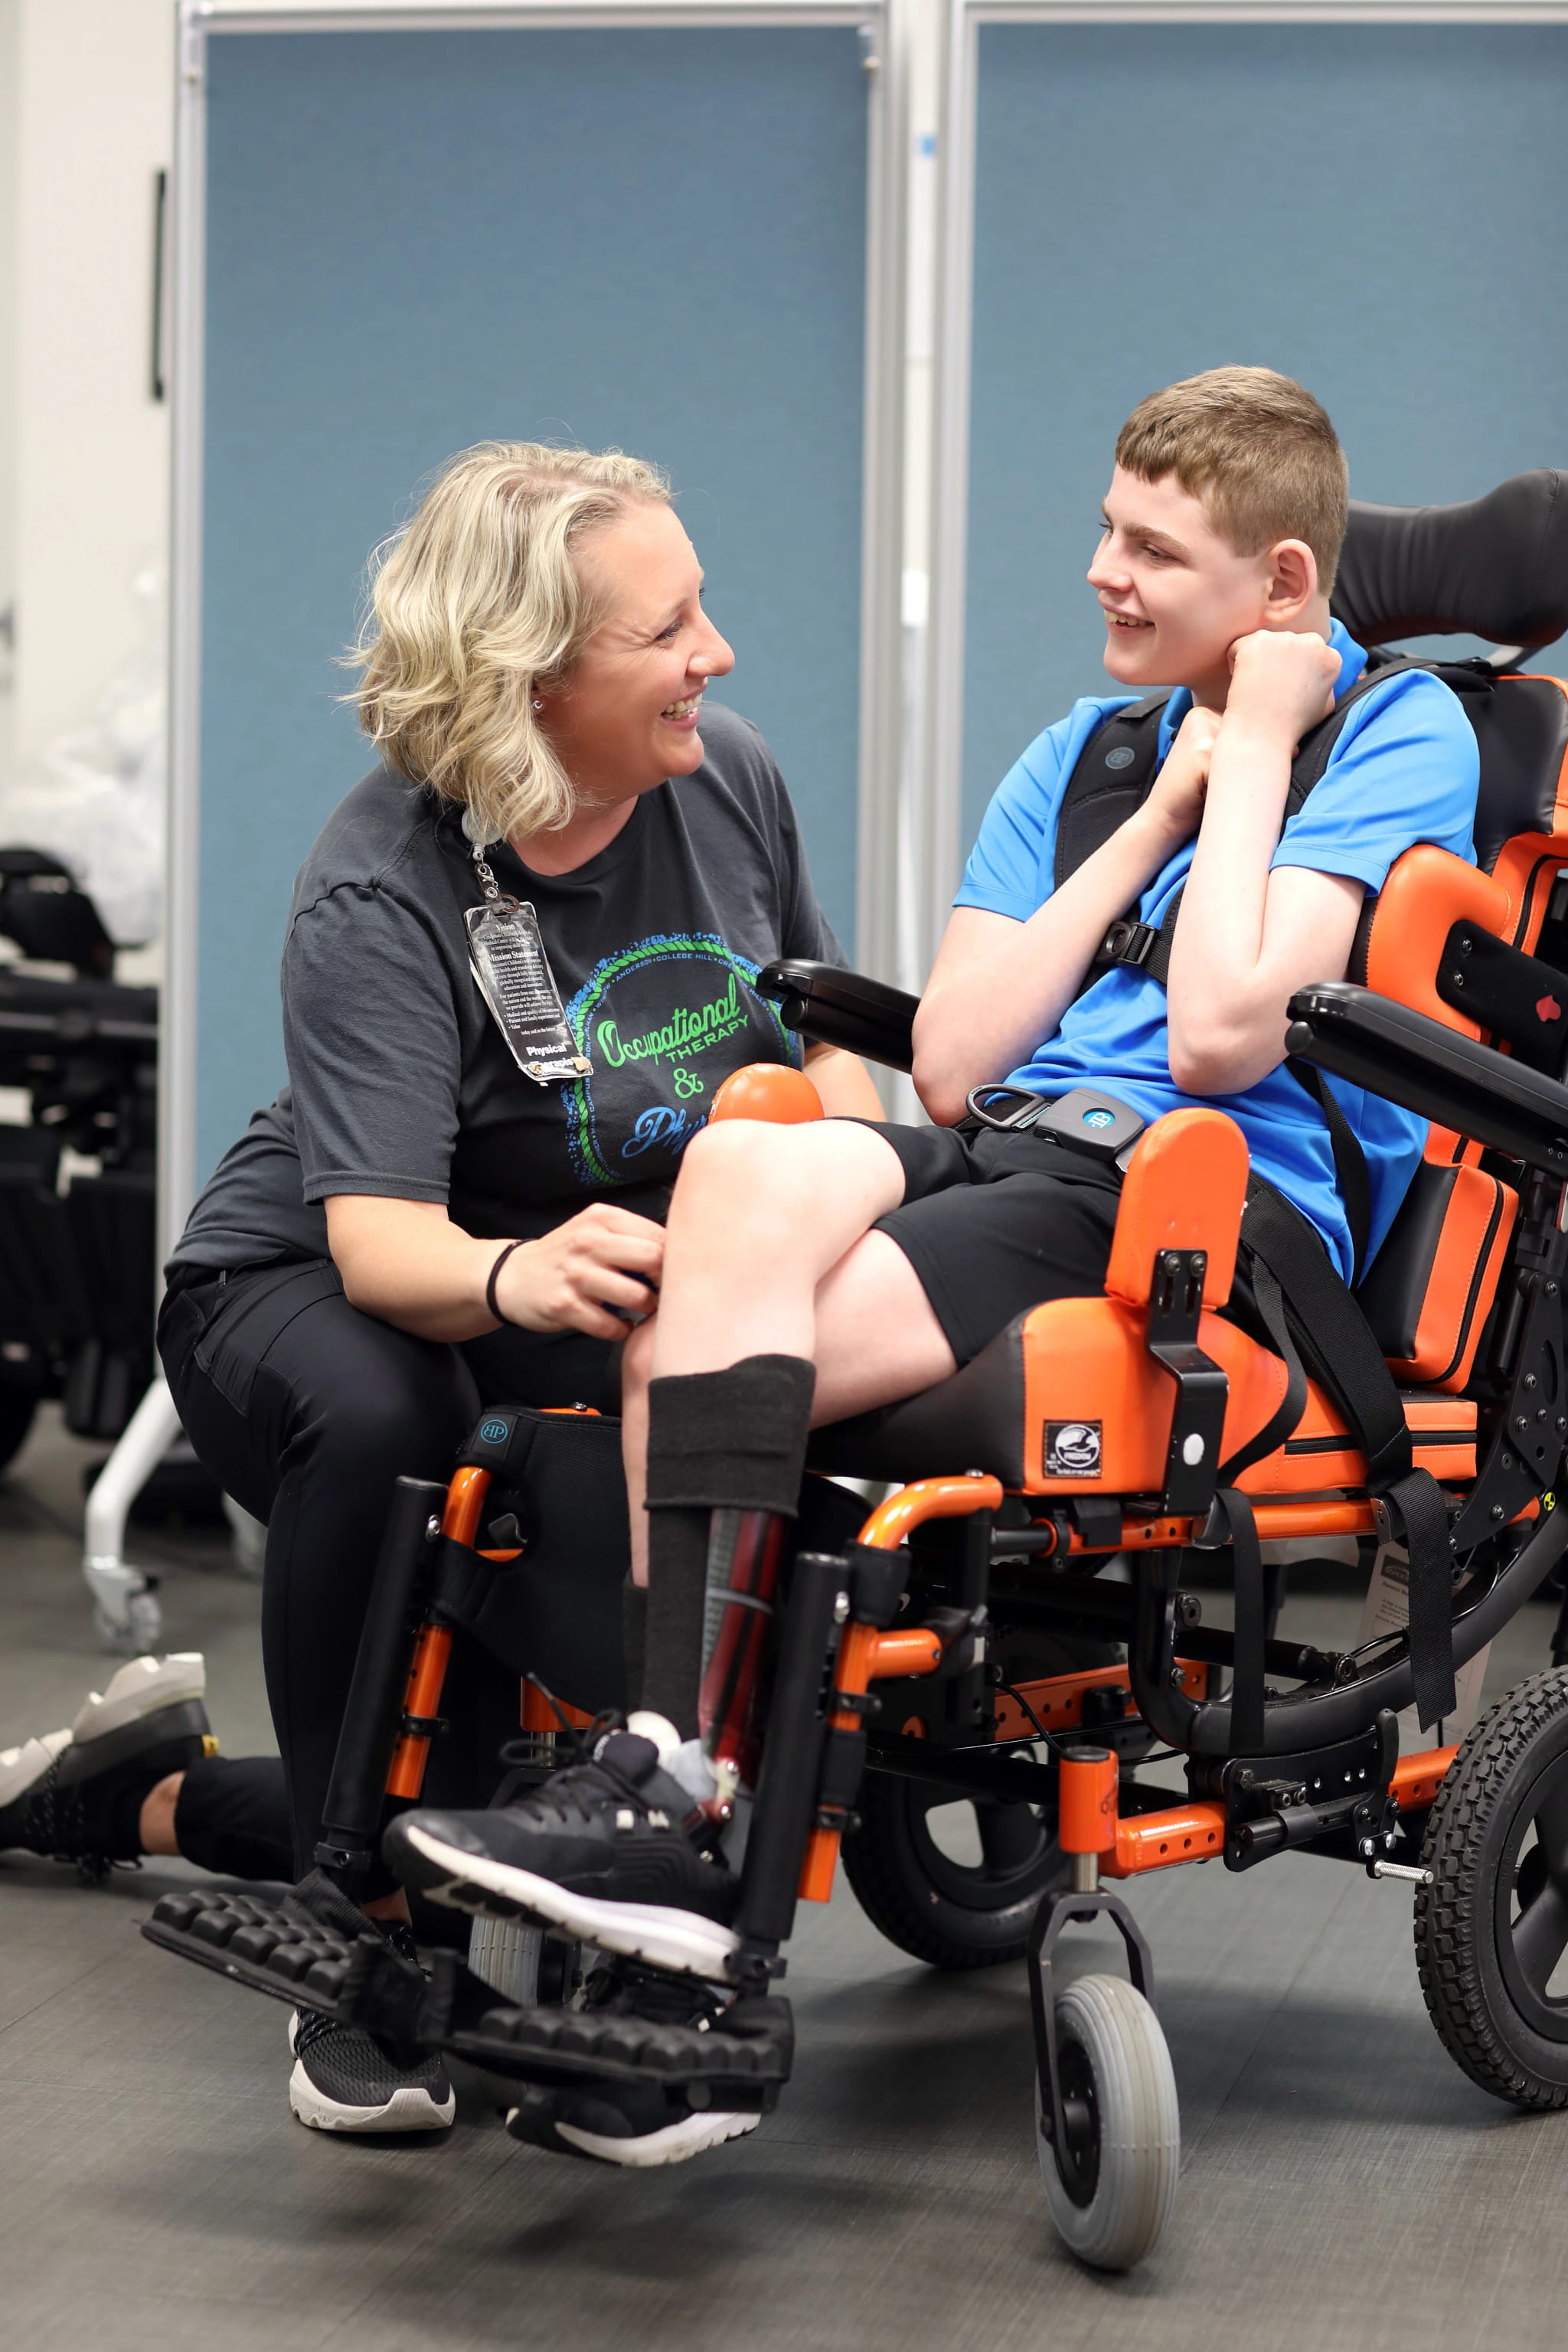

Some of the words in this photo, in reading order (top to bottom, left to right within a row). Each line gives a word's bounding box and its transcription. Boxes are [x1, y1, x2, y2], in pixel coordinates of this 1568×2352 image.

[495, 923, 515, 932] Vision
[488, 952, 511, 961] Mission
[511, 949, 538, 959] Statement
[656, 952, 692, 962] COLLEGE
[695, 953, 713, 962] HILL
[616, 959, 652, 981] ANDERSON
[597, 973, 740, 1067] Occupational
[665, 1014, 748, 1063] THERAPY
[526, 1044, 567, 1057] Physical
[530, 1057, 575, 1070] Terapis
[673, 1068, 704, 1099] &
[585, 1077, 595, 1112] CAMPUS
